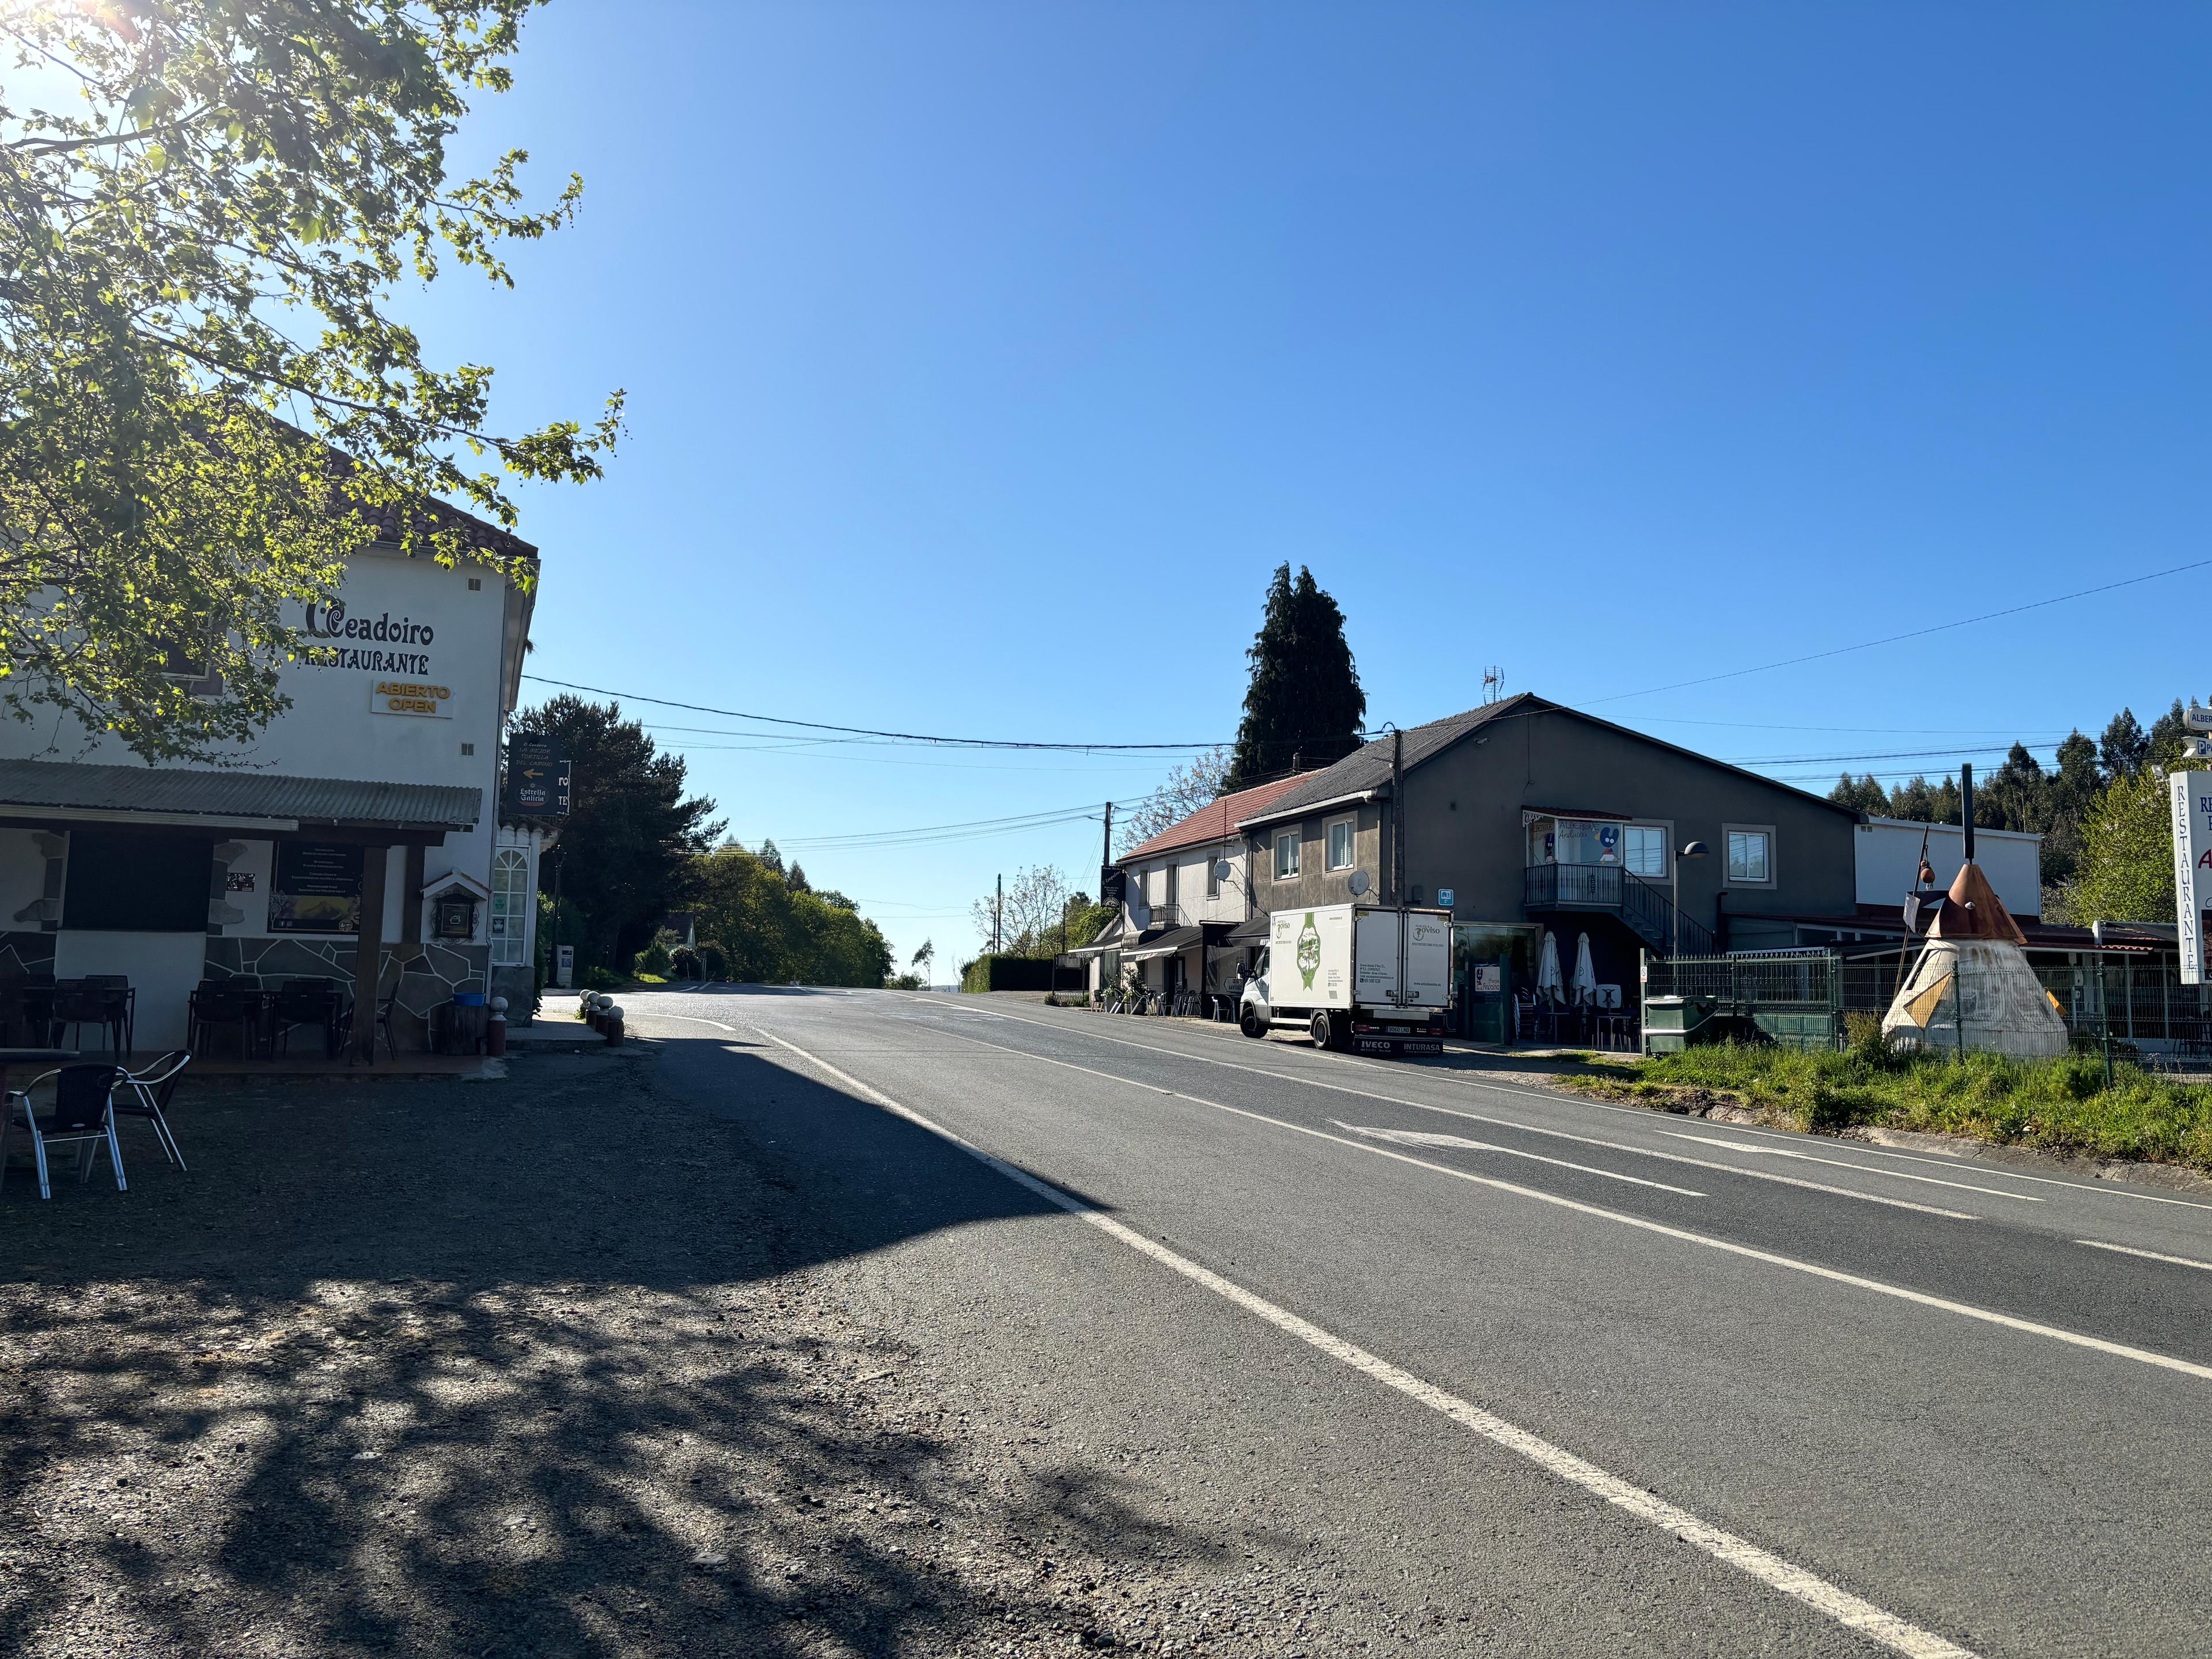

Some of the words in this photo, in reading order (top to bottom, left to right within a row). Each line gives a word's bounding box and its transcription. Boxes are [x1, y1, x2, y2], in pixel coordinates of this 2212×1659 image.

[326, 606, 434, 646] Ceadoiro
[376, 681, 451, 699] ABIERTO
[389, 698, 437, 714] OPEN
[520, 787, 546, 796] Estrella
[1559, 822, 1600, 831] ALBERGUE
[2177, 786, 2195, 969] RESTAURANTE
[1361, 1040, 1391, 1049] IVECO
[1404, 1043, 1440, 1051] INTURASA
